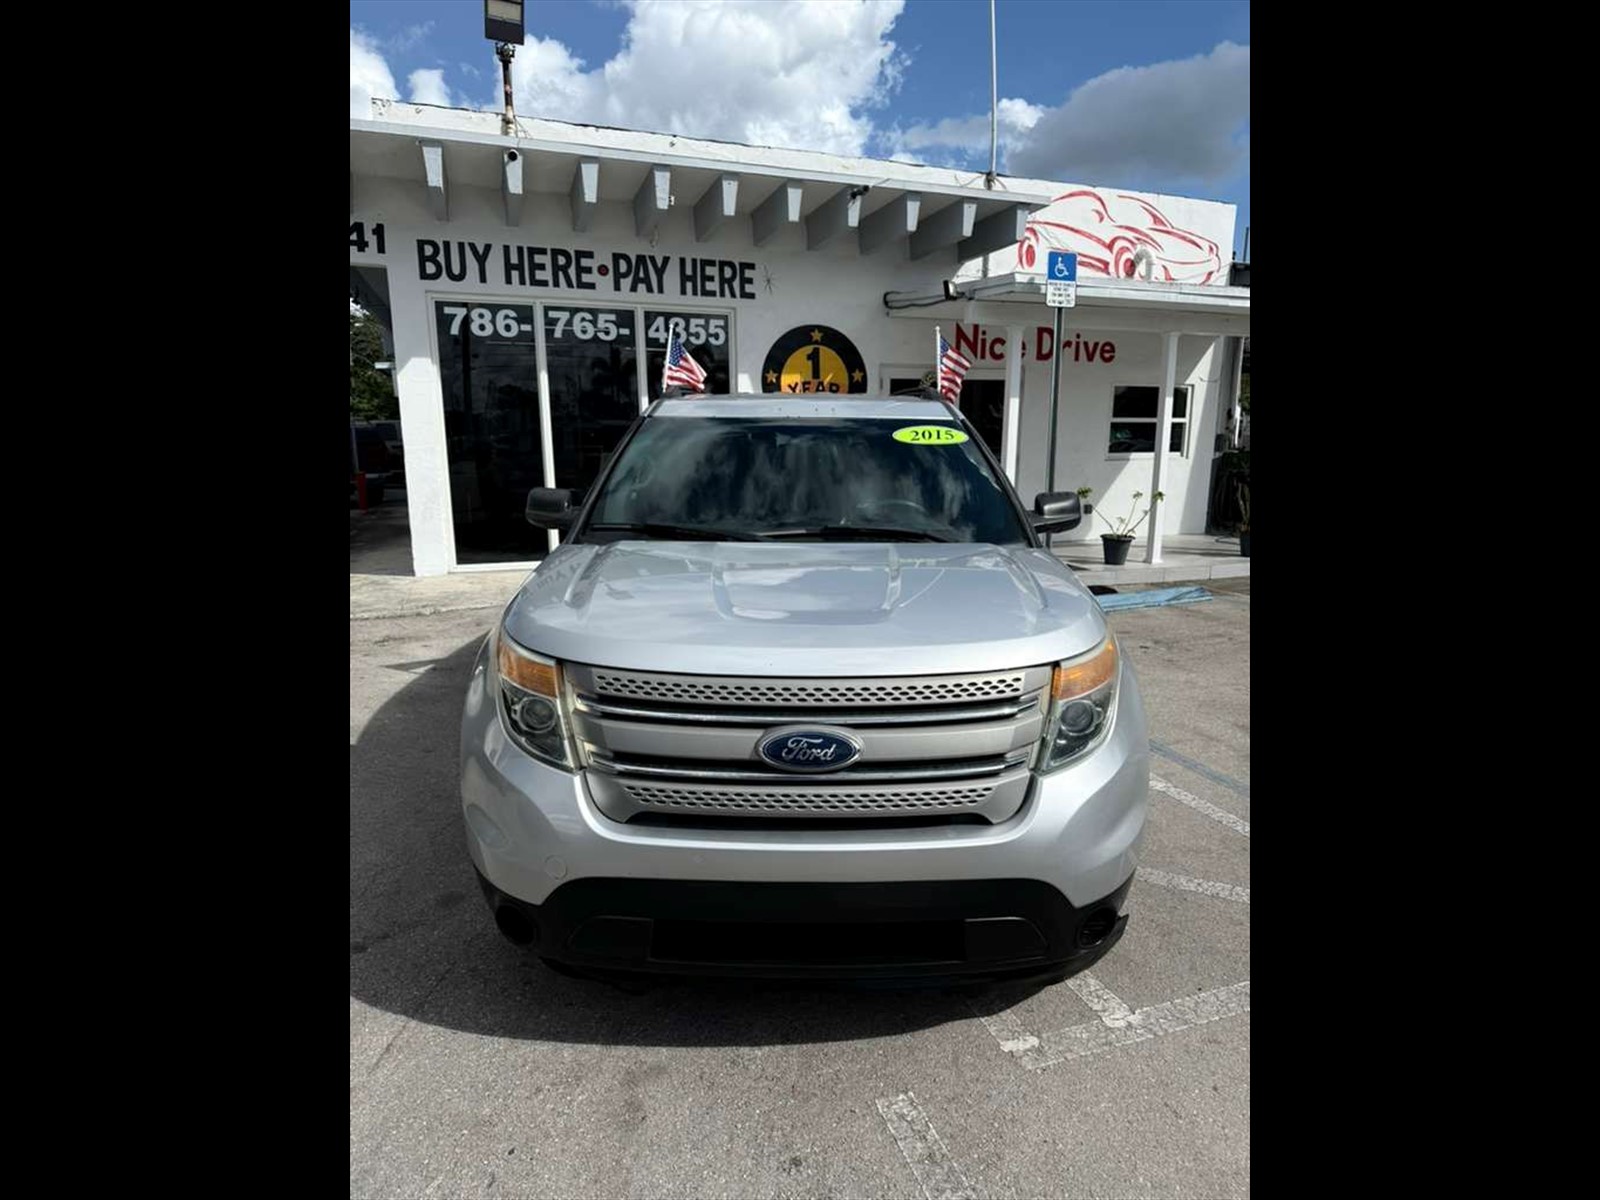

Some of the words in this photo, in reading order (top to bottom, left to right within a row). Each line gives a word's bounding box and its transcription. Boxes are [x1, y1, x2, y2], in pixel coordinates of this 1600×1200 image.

[416, 239, 492, 284] BUY
[503, 244, 596, 290] HERE
[612, 252, 671, 294] PAY
[679, 257, 756, 299] HERE
[443, 306, 532, 338] 786-
[548, 310, 630, 341] 765-
[955, 323, 1026, 360] Nic
[806, 347, 820, 380] 1
[910, 429, 955, 442] 2015
[782, 736, 837, 761] Ford
